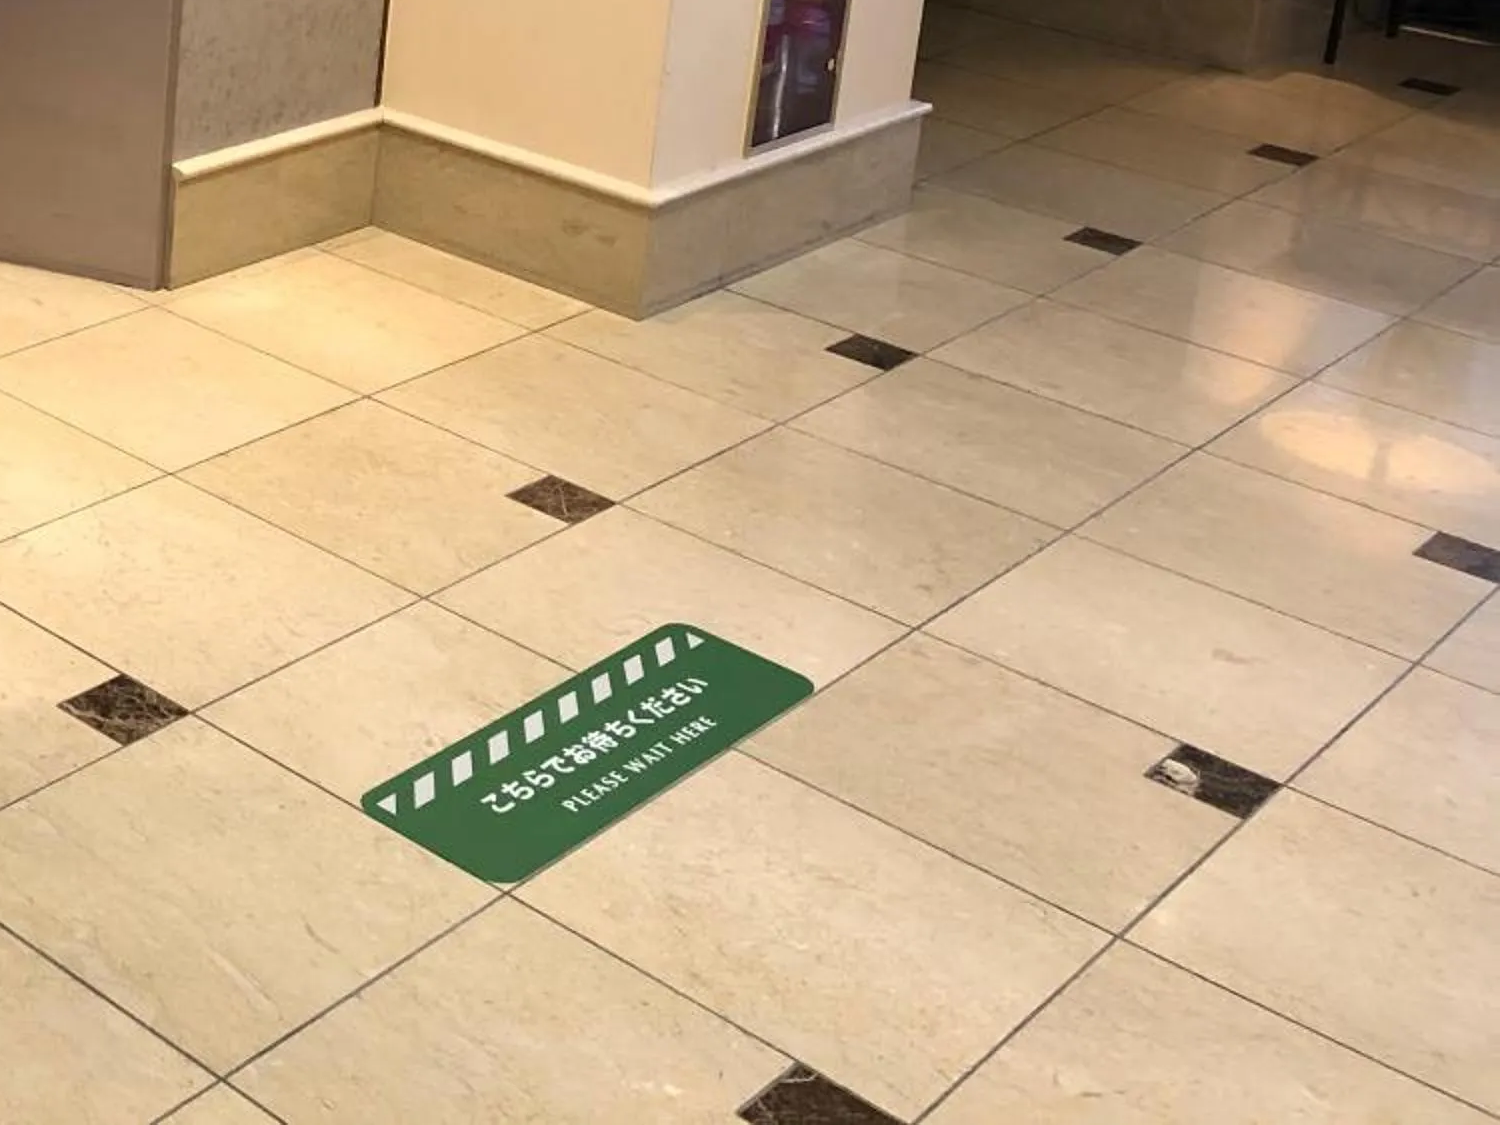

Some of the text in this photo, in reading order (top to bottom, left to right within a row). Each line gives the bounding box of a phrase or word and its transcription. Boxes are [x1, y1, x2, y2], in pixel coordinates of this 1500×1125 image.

[480, 677, 708, 814] こちらでお待ちください
[561, 715, 717, 812] PLEASE WAIT HERE
